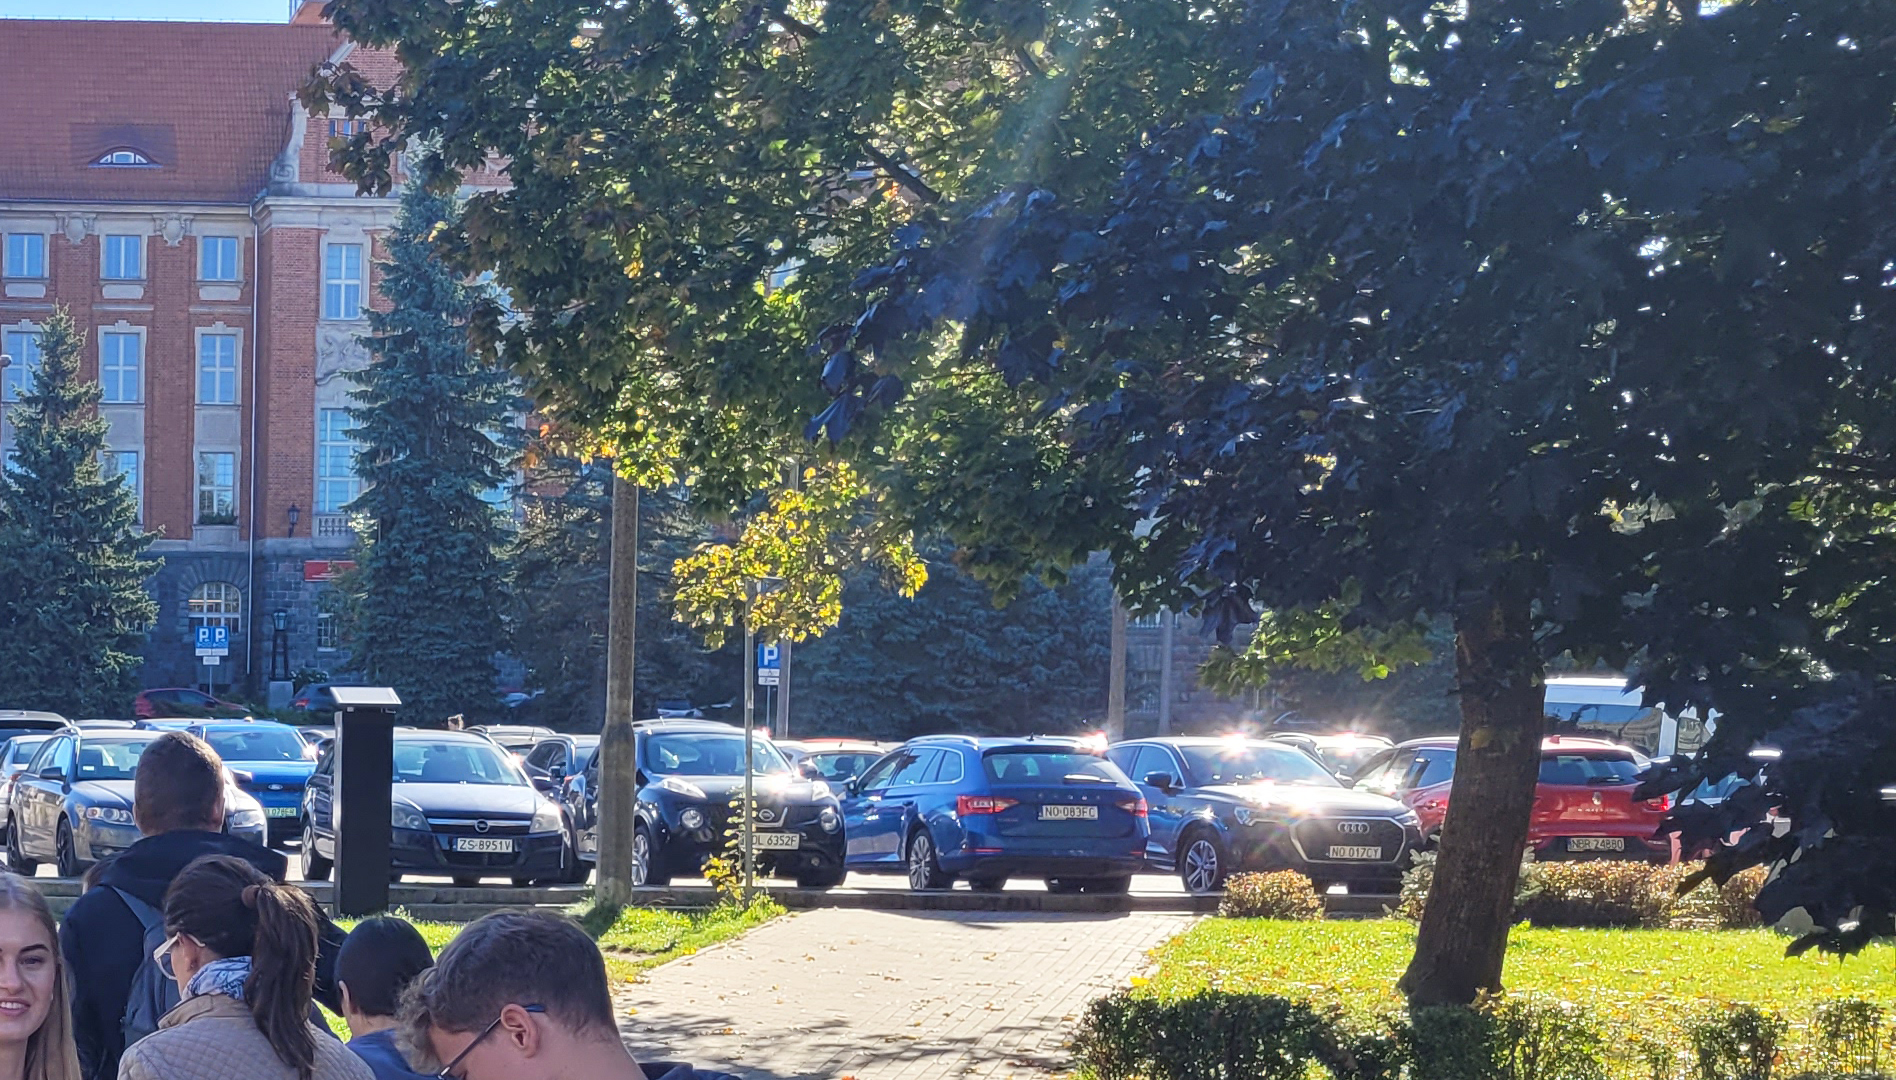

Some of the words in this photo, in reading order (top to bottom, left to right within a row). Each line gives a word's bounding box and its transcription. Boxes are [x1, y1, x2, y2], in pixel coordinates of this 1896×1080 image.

[199, 628, 209, 642] P
[215, 628, 225, 642] P
[764, 646, 778, 665] P
[459, 840, 475, 850] ZS
[478, 840, 511, 850] 8951V
[767, 835, 797, 846] 6352F
[1332, 847, 1345, 857] NO
